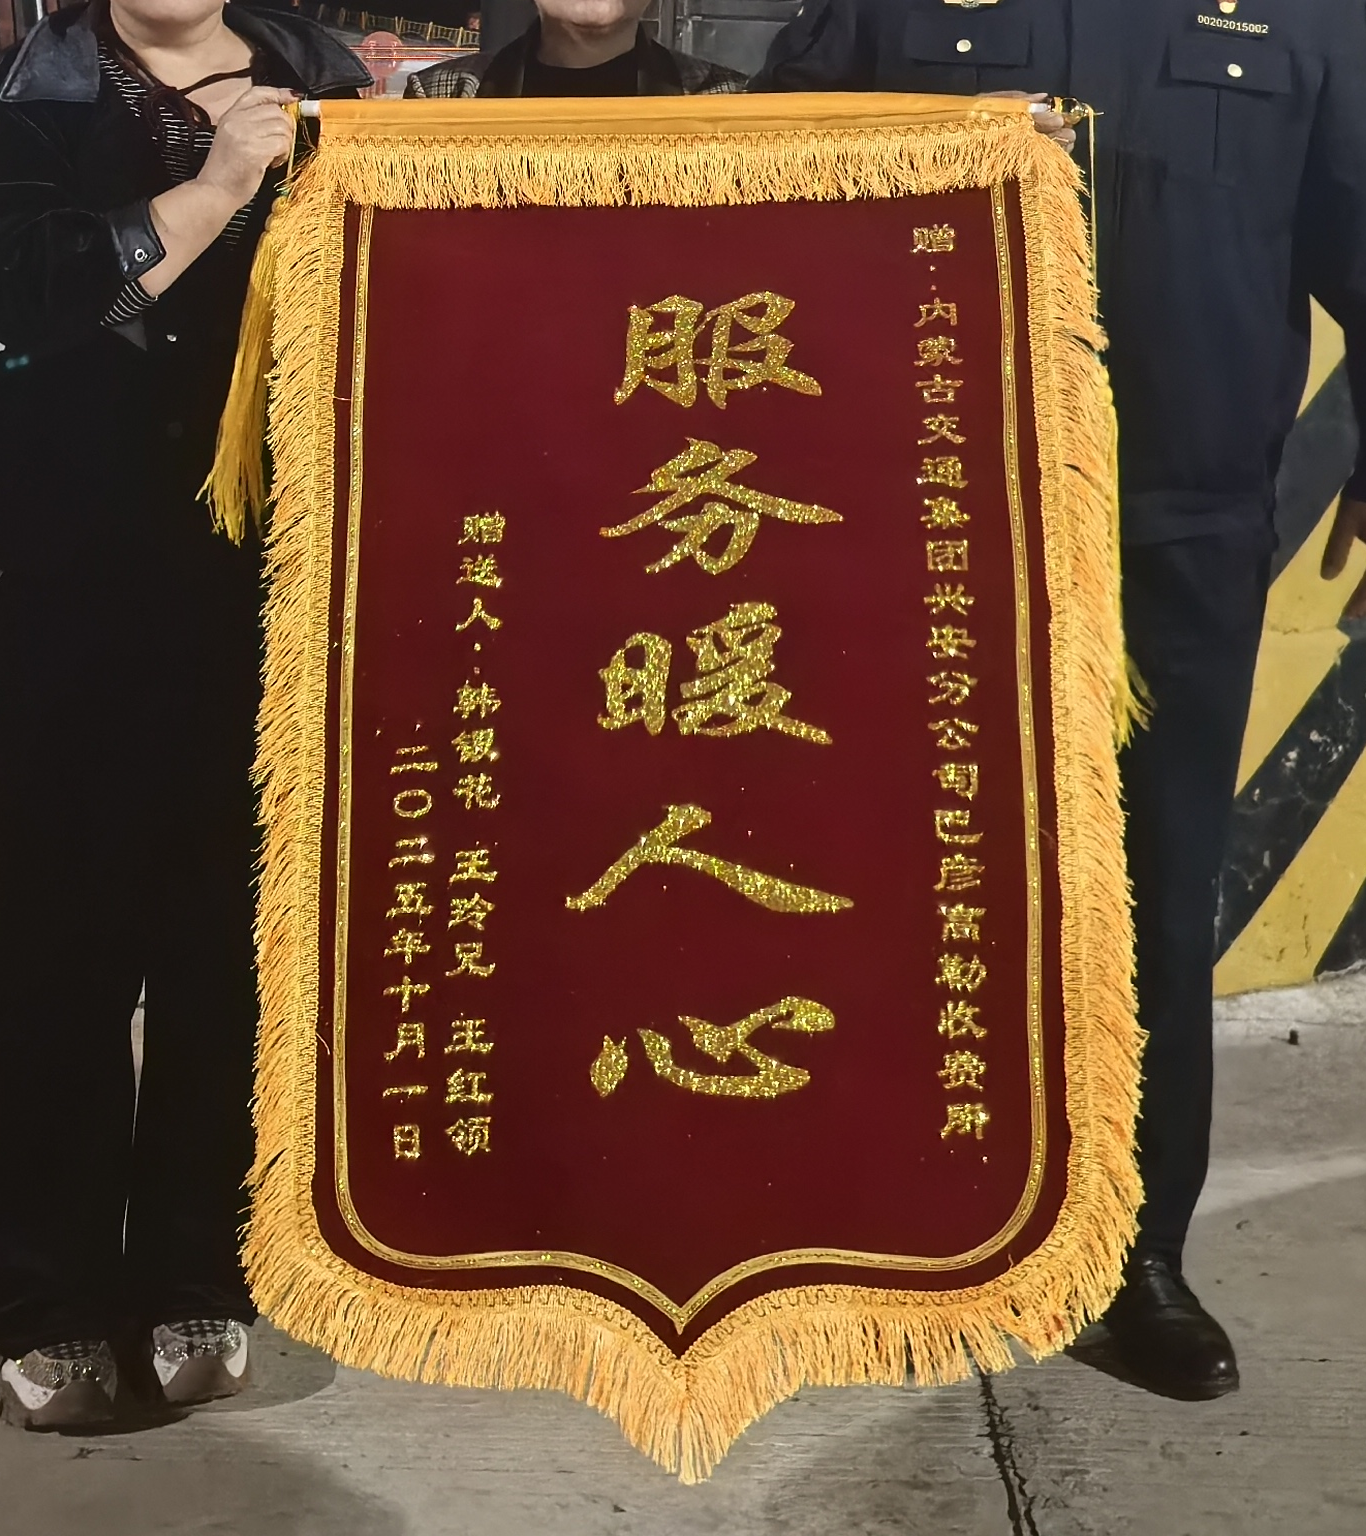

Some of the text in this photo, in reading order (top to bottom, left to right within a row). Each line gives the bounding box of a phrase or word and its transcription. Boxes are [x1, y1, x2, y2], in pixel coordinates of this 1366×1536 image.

[1197, 14, 1269, 34] 00202015002
[563, 290, 856, 1099] 服务暖人心
[443, 1018, 495, 1157] 王红领
